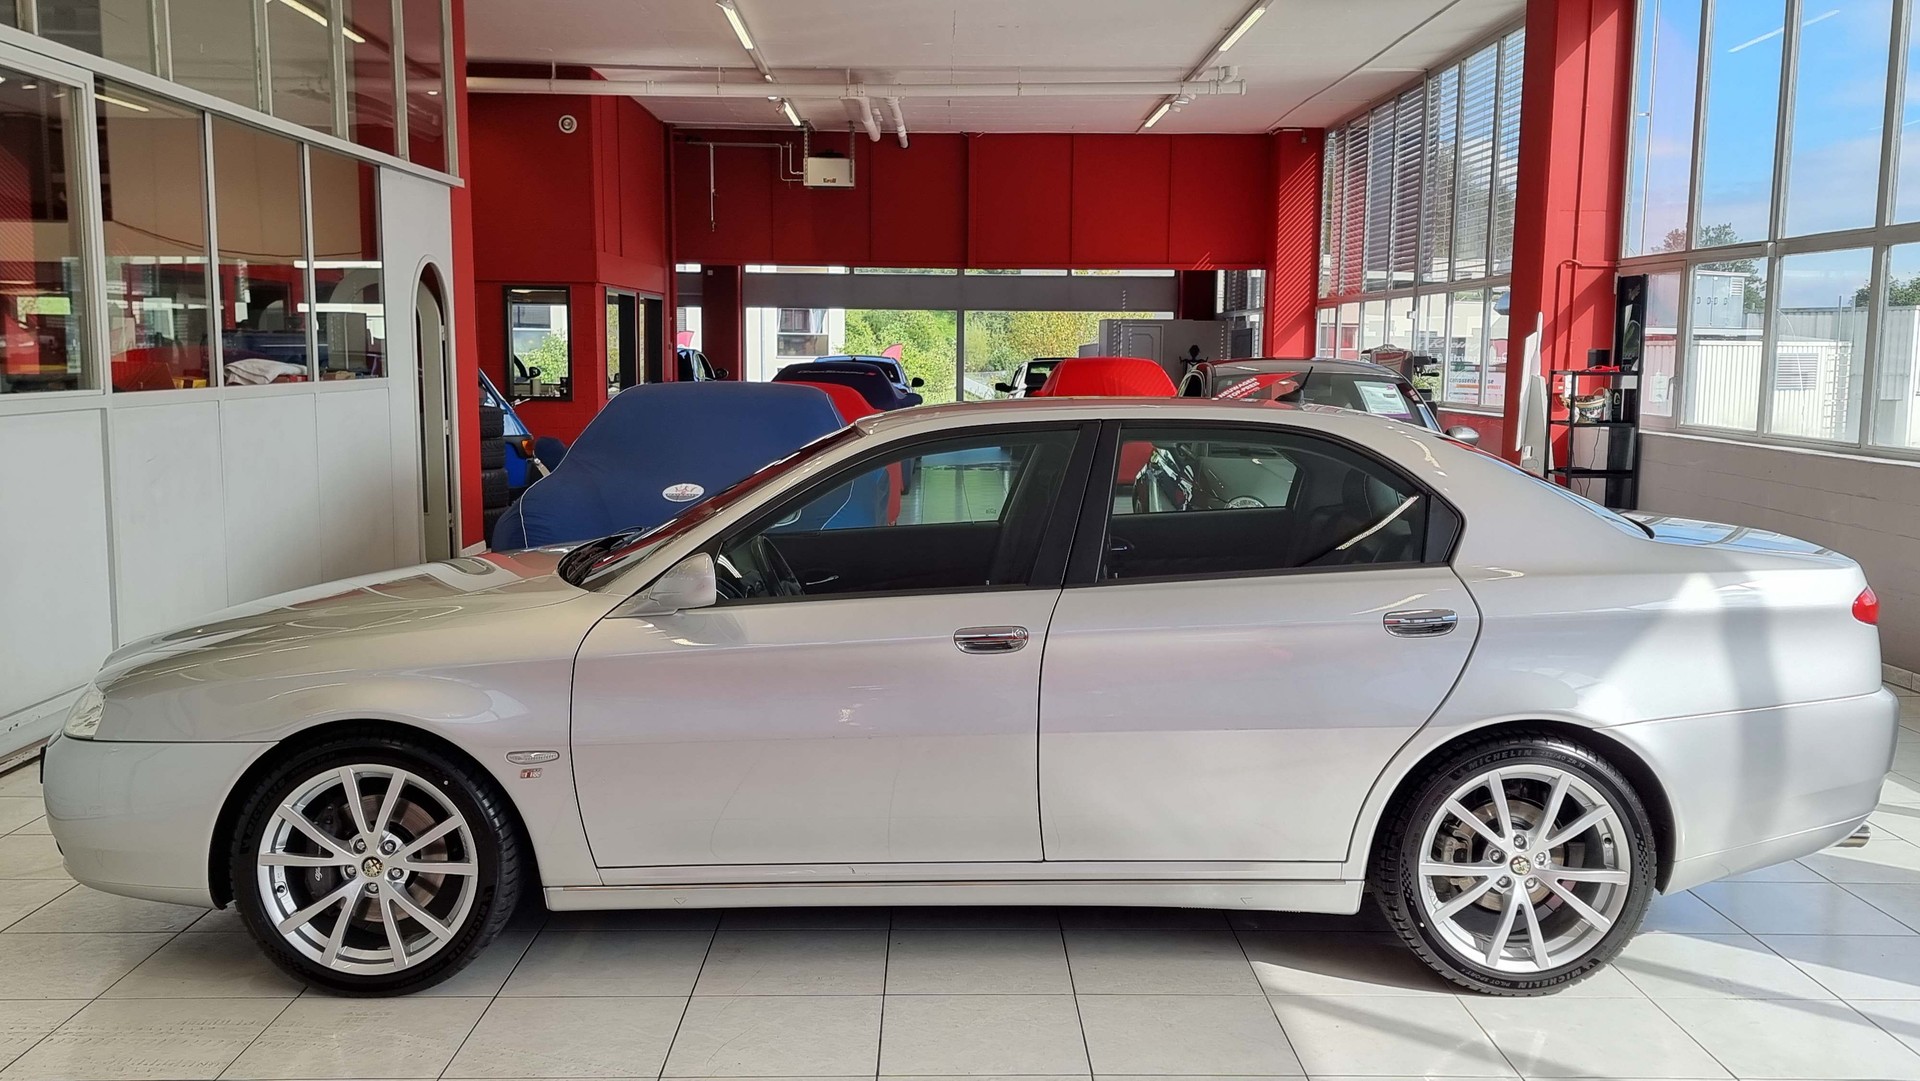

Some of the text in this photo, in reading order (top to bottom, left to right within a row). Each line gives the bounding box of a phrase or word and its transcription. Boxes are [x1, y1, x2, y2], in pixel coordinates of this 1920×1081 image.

[1468, 749, 1533, 770] MICHELIN
[1465, 971, 1489, 982] SPORT
[1518, 970, 1582, 989] MICHELIN
